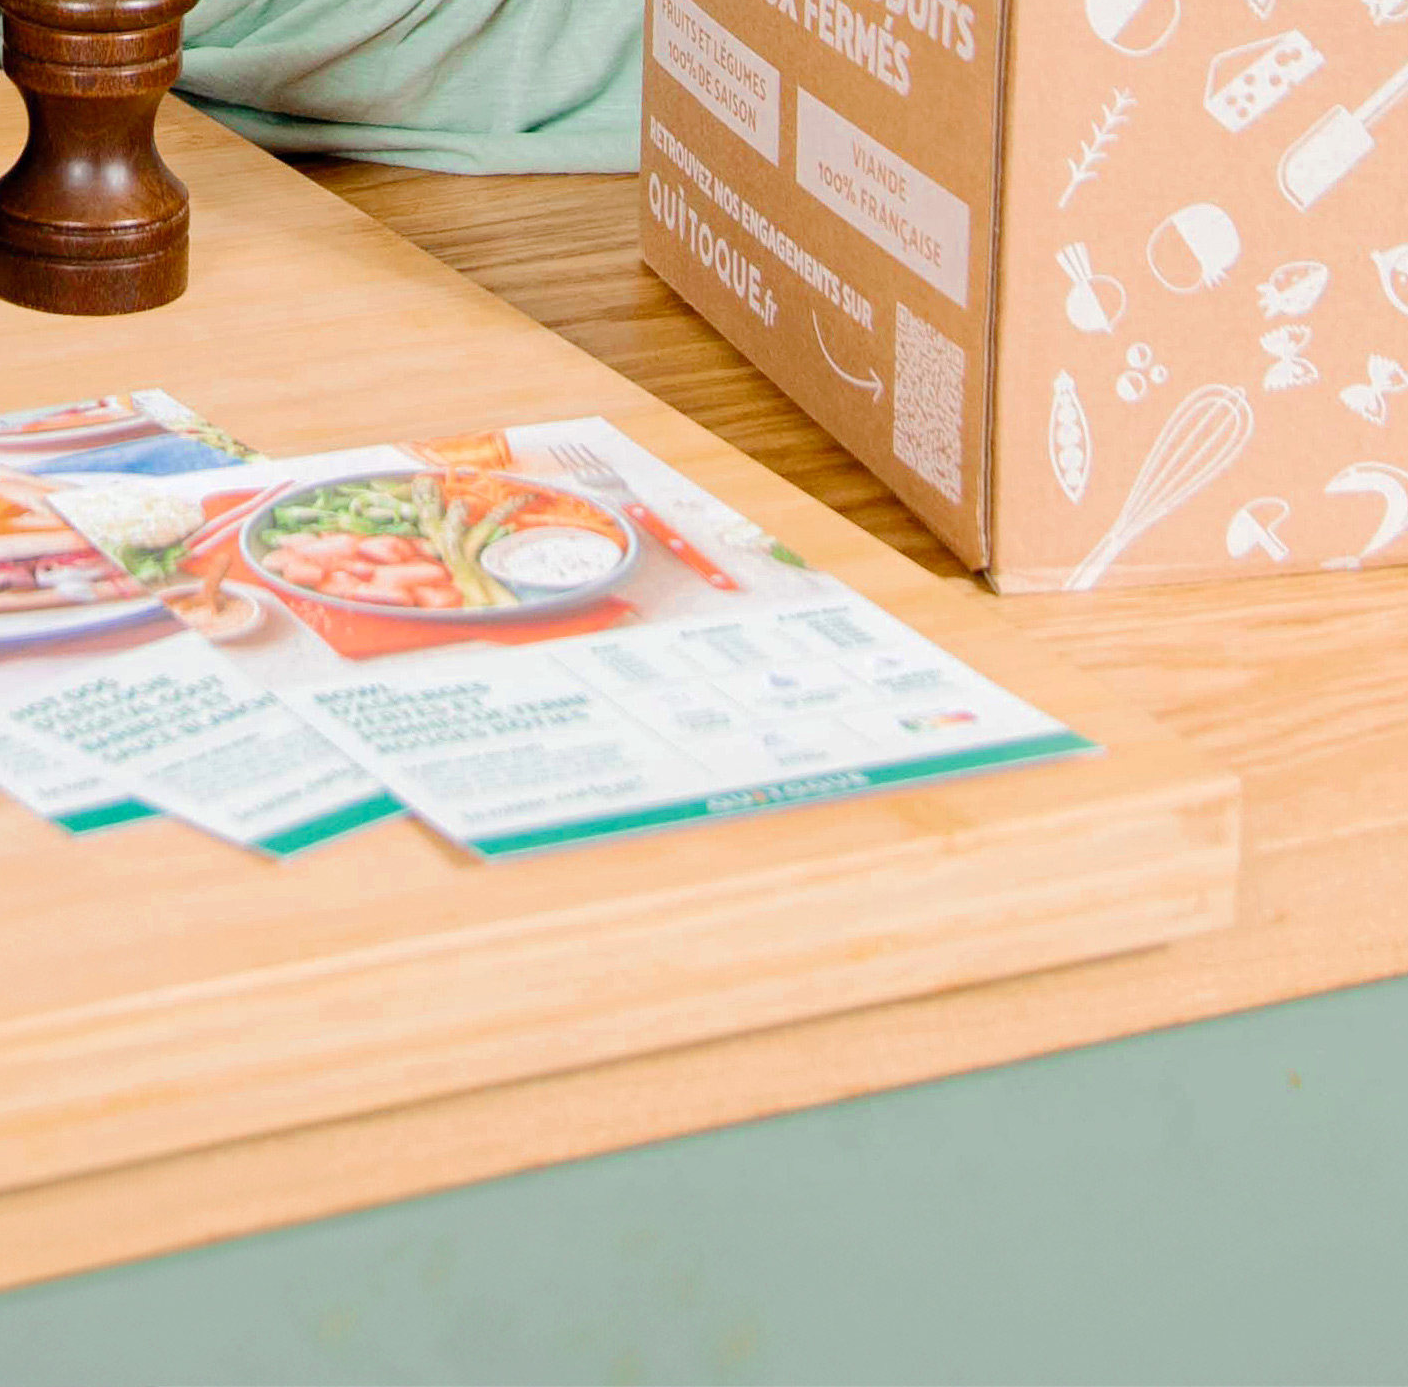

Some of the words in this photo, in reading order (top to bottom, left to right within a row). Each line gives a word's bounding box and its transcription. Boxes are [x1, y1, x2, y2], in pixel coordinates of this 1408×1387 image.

[668, 39, 697, 80] 100%
[698, 63, 712, 96] DE
[713, 77, 758, 133] SAISON
[698, 28, 712, 54] ET
[713, 39, 767, 102] LÉGUMES
[817, 161, 857, 204] 100%
[860, 188, 943, 268] FRANÇAISE
[852, 140, 907, 203] VIANDE
[649, 115, 713, 200] RETROUVEZ
[713, 176, 741, 223] NOS
[741, 200, 841, 307] ENGAGEMENTS
[841, 282, 875, 333] SUR
